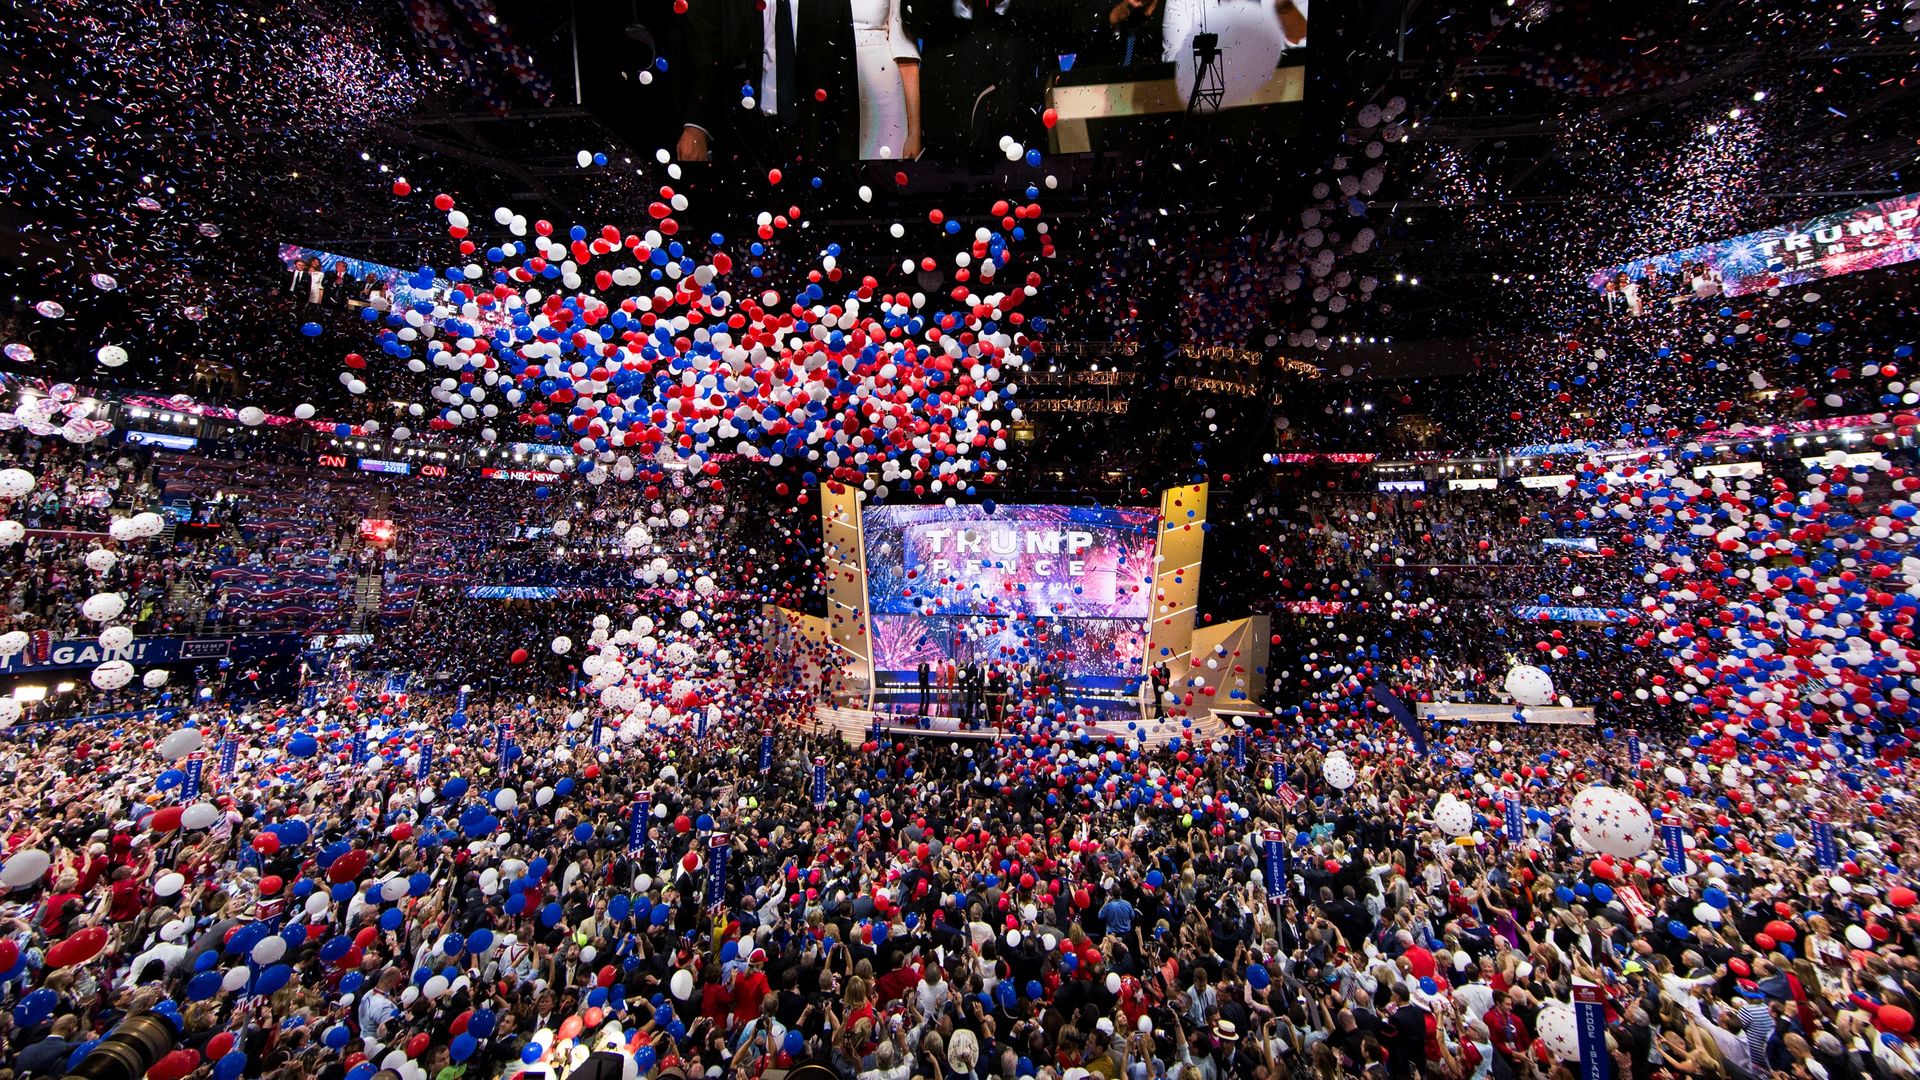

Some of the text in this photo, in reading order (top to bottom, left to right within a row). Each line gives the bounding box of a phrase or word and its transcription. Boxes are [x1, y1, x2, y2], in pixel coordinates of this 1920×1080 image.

[1756, 208, 1918, 256] TRUMP
[1766, 227, 1914, 267] PENCE
[319, 455, 346, 468] CNN
[384, 465, 407, 473] 2016
[421, 464, 447, 476] CNN
[510, 471, 531, 480] NBC
[926, 530, 1093, 554] TRUMP
[933, 560, 1085, 576] PENCE
[53, 643, 146, 665] GAIN!
[635, 803, 643, 844] ILLINOIS
[1506, 801, 1514, 837] NEVADA
[1514, 803, 1522, 838] NEVADA
[1585, 1004, 1595, 1039] RHODE
[1590, 1044, 1600, 1080] ISLAN
